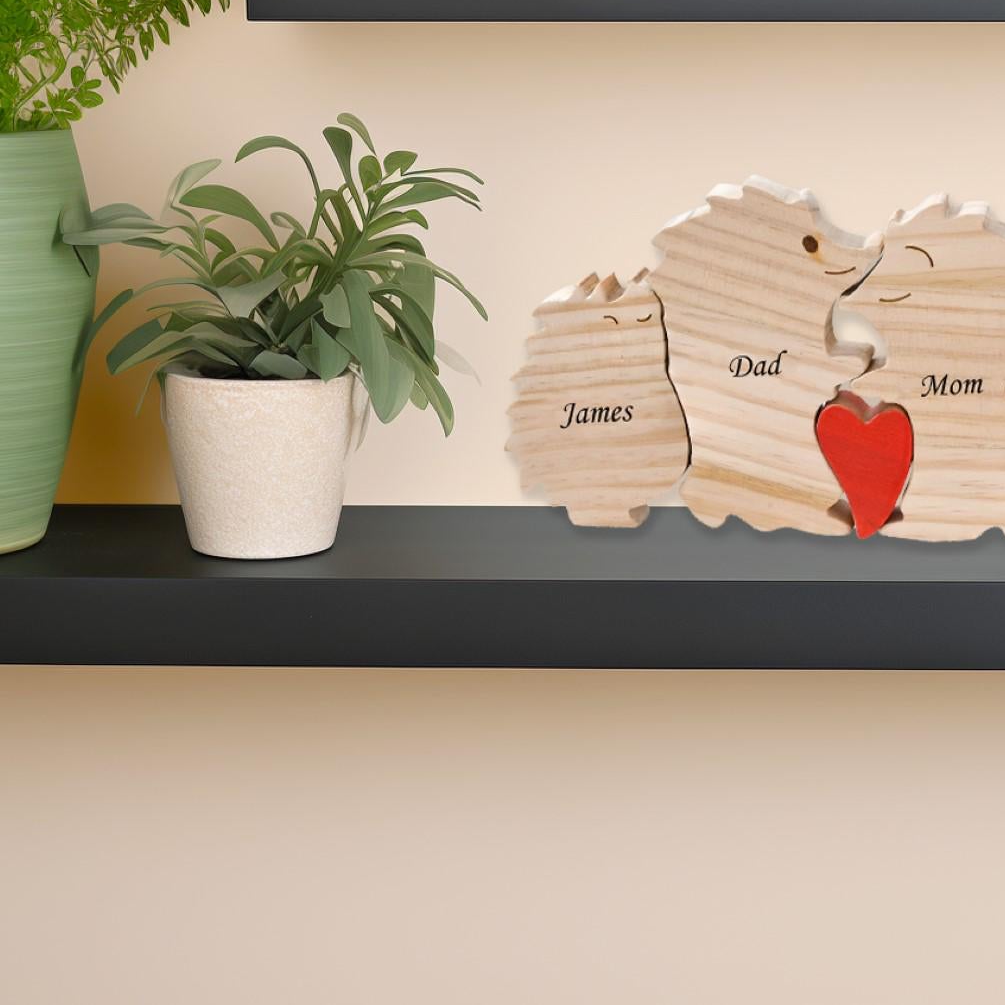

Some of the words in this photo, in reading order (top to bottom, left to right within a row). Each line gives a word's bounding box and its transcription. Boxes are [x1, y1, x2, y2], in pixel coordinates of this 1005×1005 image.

[729, 349, 788, 378] Dad
[920, 373, 983, 398] Mom
[559, 402, 634, 429] James
